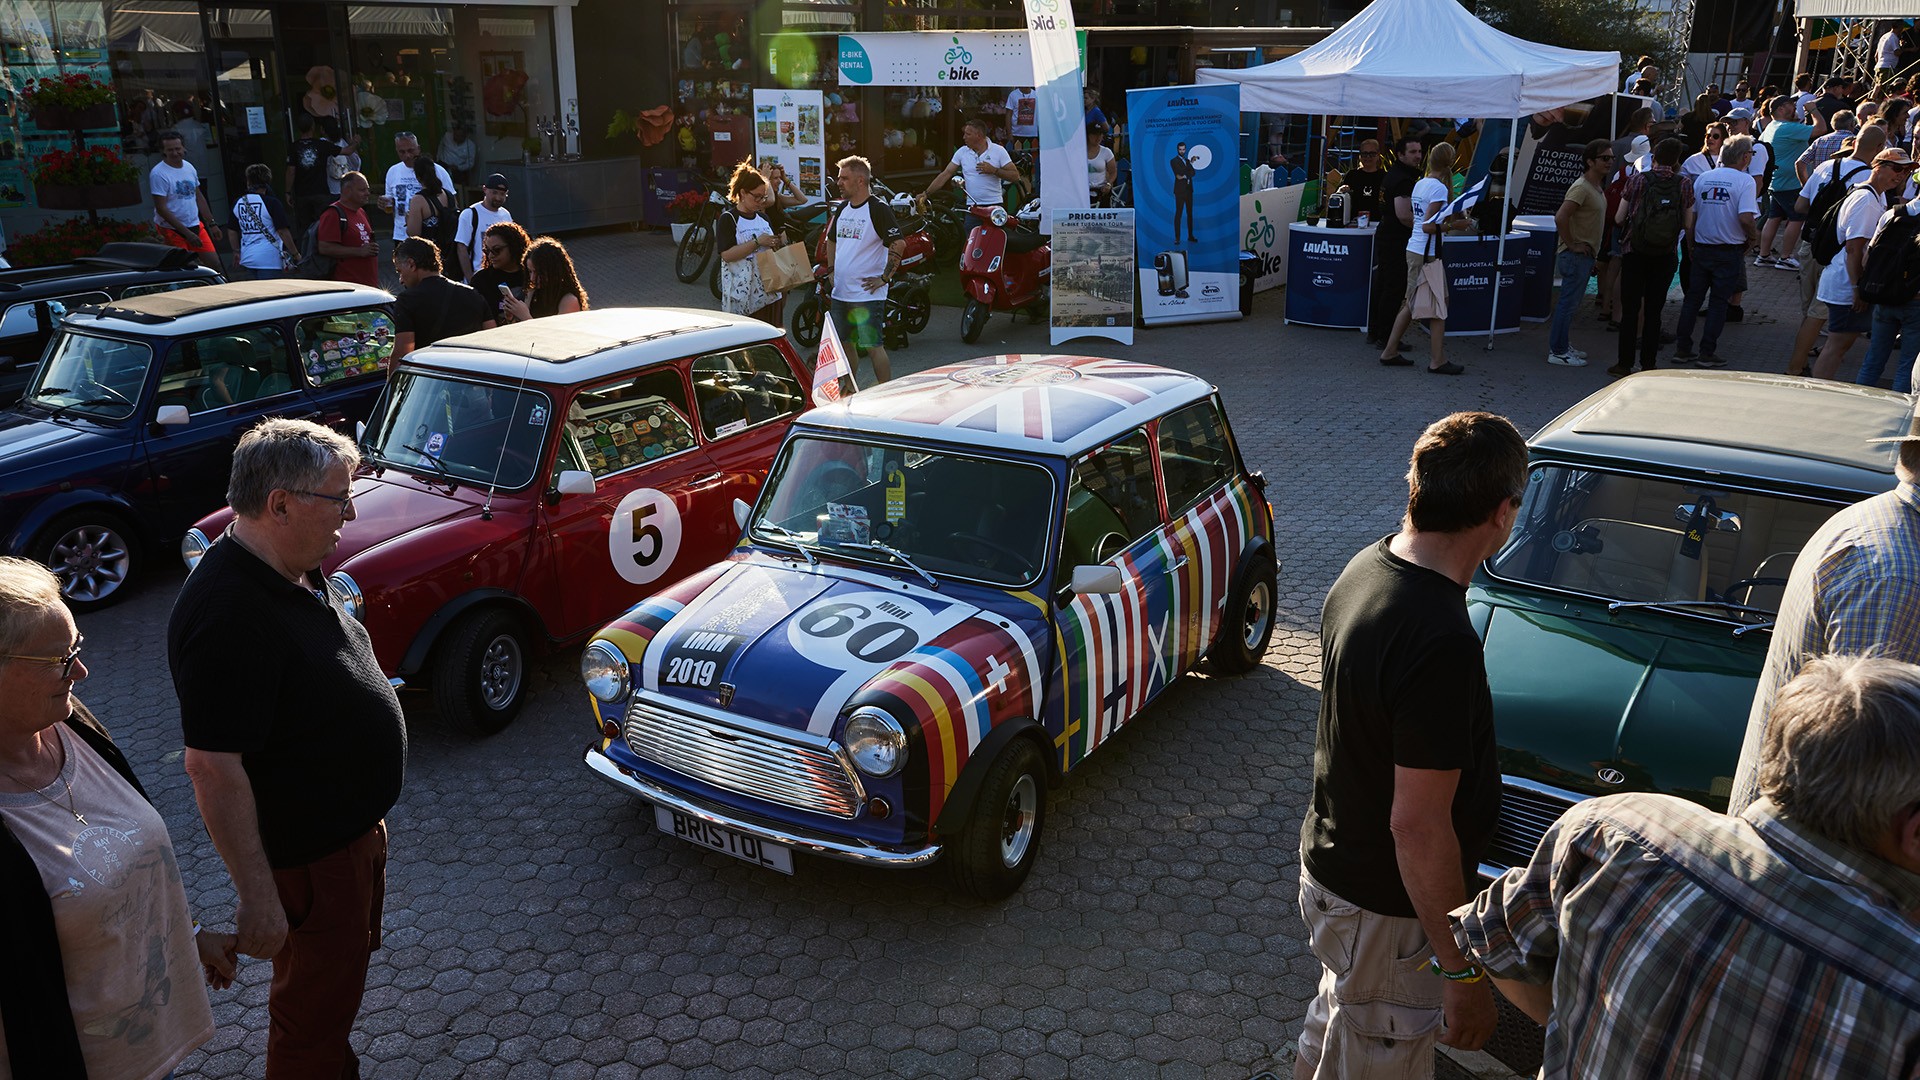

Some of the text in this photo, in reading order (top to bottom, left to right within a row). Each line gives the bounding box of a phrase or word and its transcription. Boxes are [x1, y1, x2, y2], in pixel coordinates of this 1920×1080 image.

[840, 61, 864, 69] RENTAL
[937, 66, 980, 80] e-bike
[1167, 97, 1199, 107] LAVAZZA
[1541, 149, 1583, 161] TI OFFRIA
[1538, 157, 1584, 170] UNA GRAN
[1532, 173, 1575, 185] DI LAVOR
[1068, 212, 1096, 220] PRICE
[1303, 240, 1349, 255] LAVAZZA
[1453, 275, 1489, 286] LAVAZZA
[632, 502, 663, 567] 5
[875, 601, 913, 620] Mini
[799, 603, 919, 663] 60
[682, 631, 735, 653] IMM
[666, 657, 717, 687] 2019
[78, 829, 98, 843] MAIL
[93, 836, 111, 848] MAY
[672, 811, 774, 866] BRISTOL
[74, 842, 83, 856] AIR
